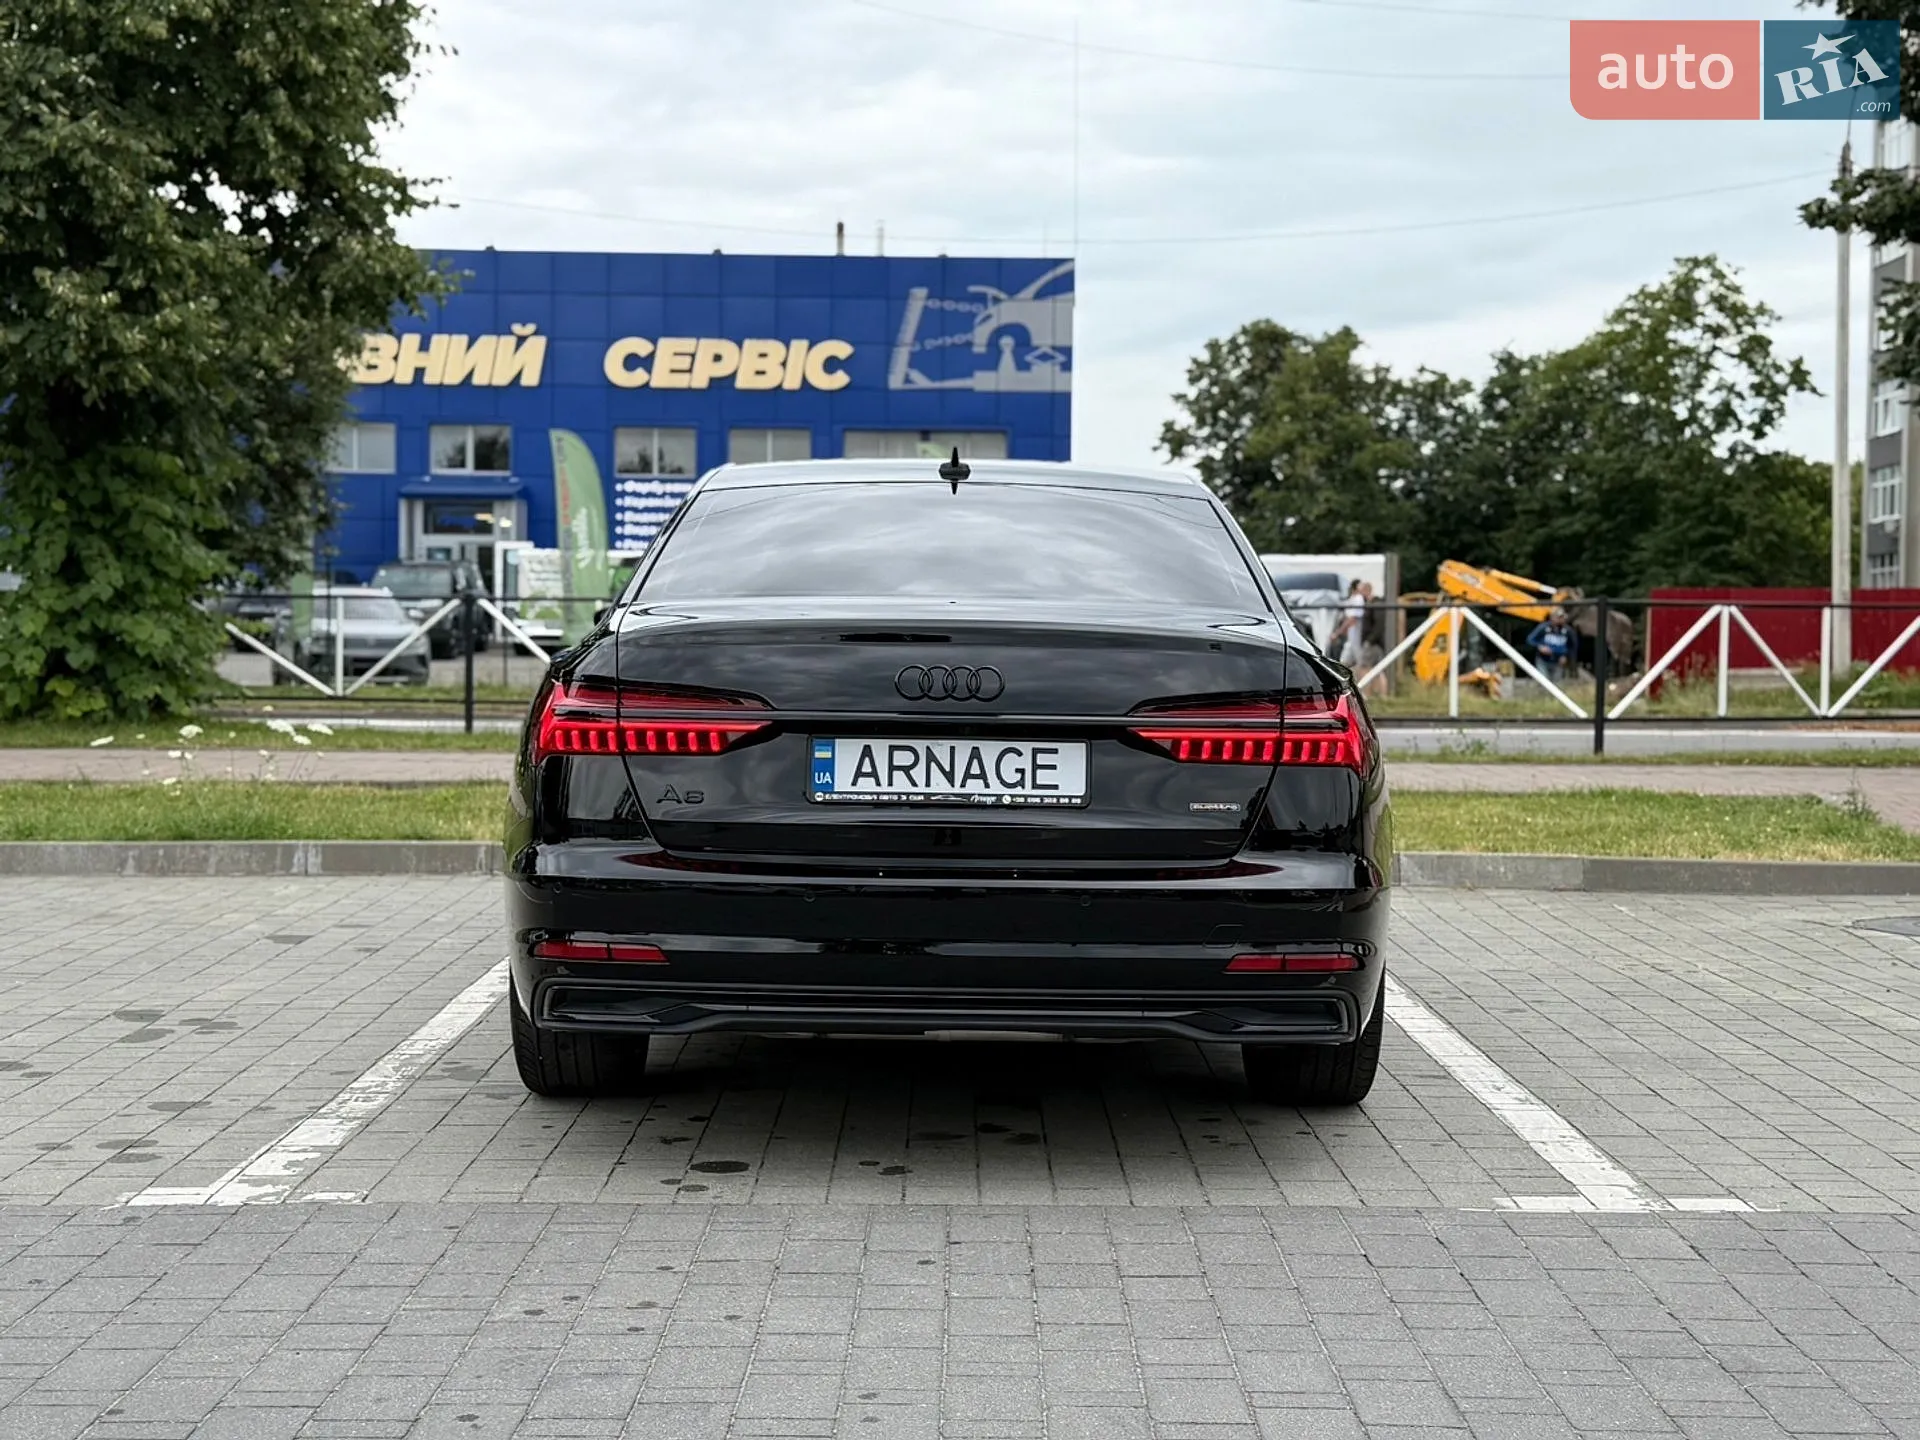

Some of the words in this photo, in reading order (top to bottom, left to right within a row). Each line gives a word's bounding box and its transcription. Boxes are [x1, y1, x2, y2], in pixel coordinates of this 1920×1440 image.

[334, 322, 548, 387] ВНИЙ
[603, 335, 855, 391] СЕРВІС
[814, 772, 832, 784] UA
[850, 744, 1060, 791] ARNAGE
[656, 784, 705, 804] A6
